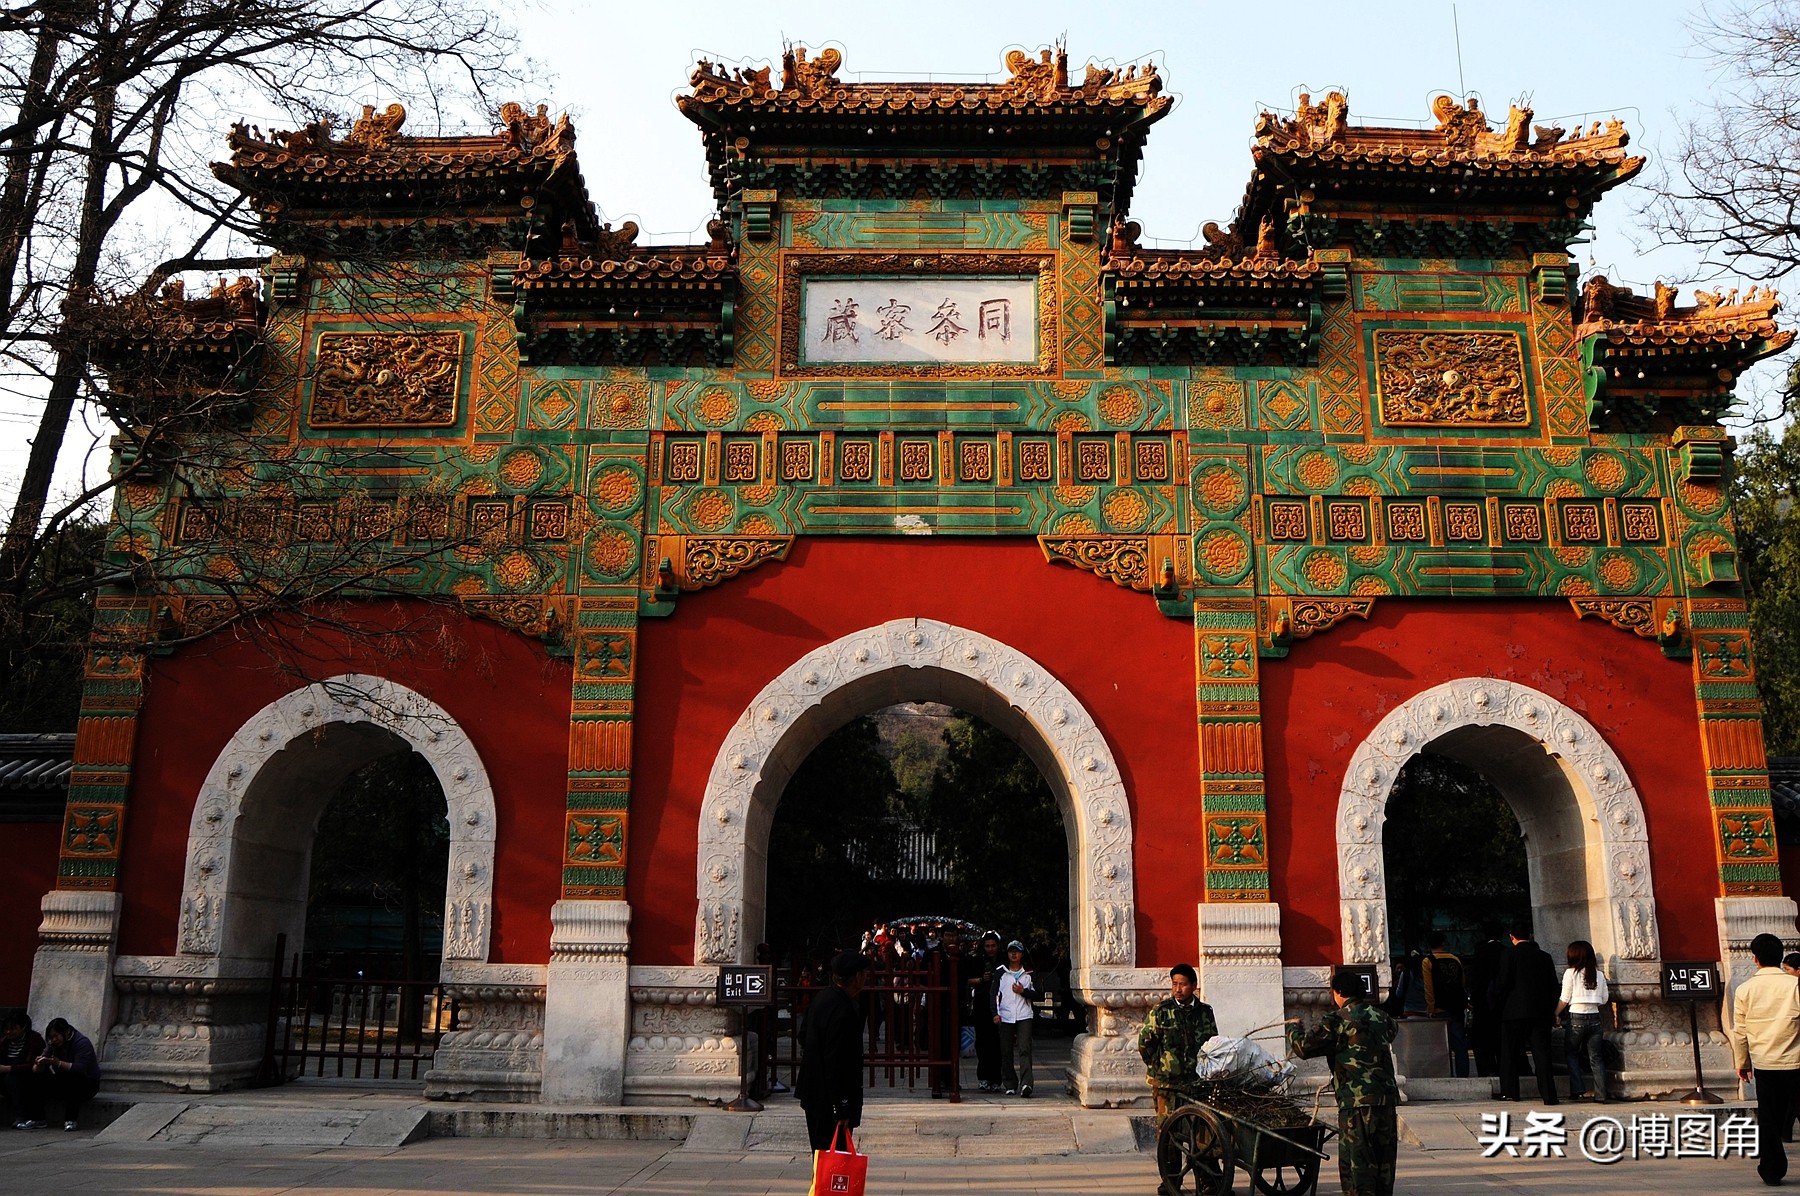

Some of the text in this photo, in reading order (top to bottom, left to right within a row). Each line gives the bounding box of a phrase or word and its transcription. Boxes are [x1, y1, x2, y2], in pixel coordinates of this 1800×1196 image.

[725, 973, 743, 986] 出口
[1669, 969, 1687, 981] 入口
[726, 987, 742, 997] Exit
